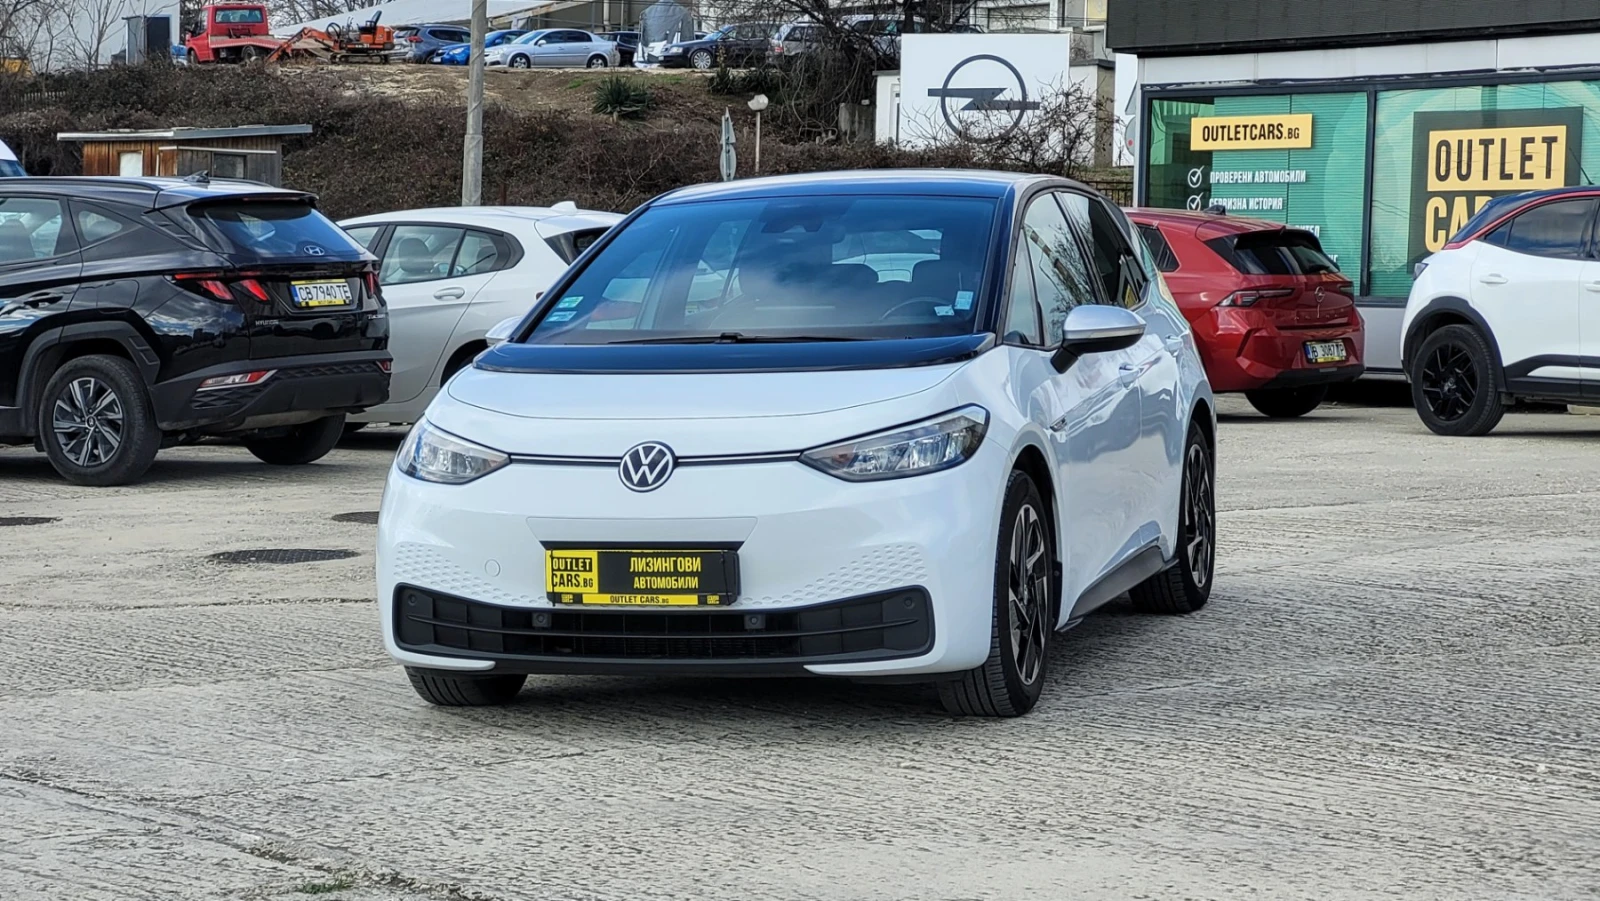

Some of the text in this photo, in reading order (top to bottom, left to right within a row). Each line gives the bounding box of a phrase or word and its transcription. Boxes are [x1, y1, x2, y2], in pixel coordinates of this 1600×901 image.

[1202, 122, 1300, 142] OUTLETCARS.BG
[1435, 136, 1558, 182] OUTLET
[1209, 170, 1306, 184] ПРОВЕРЕНИ АВТОМОБИЛИ
[1248, 197, 1283, 210] ИСТОРИЯ
[298, 284, 351, 301] CB 7940 TE
[552, 558, 591, 571] OUTLET
[629, 557, 702, 573] ЛИЗИНГОВИ
[552, 573, 594, 588] CARS.BG
[633, 576, 699, 589] АВТОМОБИЛИ
[609, 595, 638, 604] OUTLET
